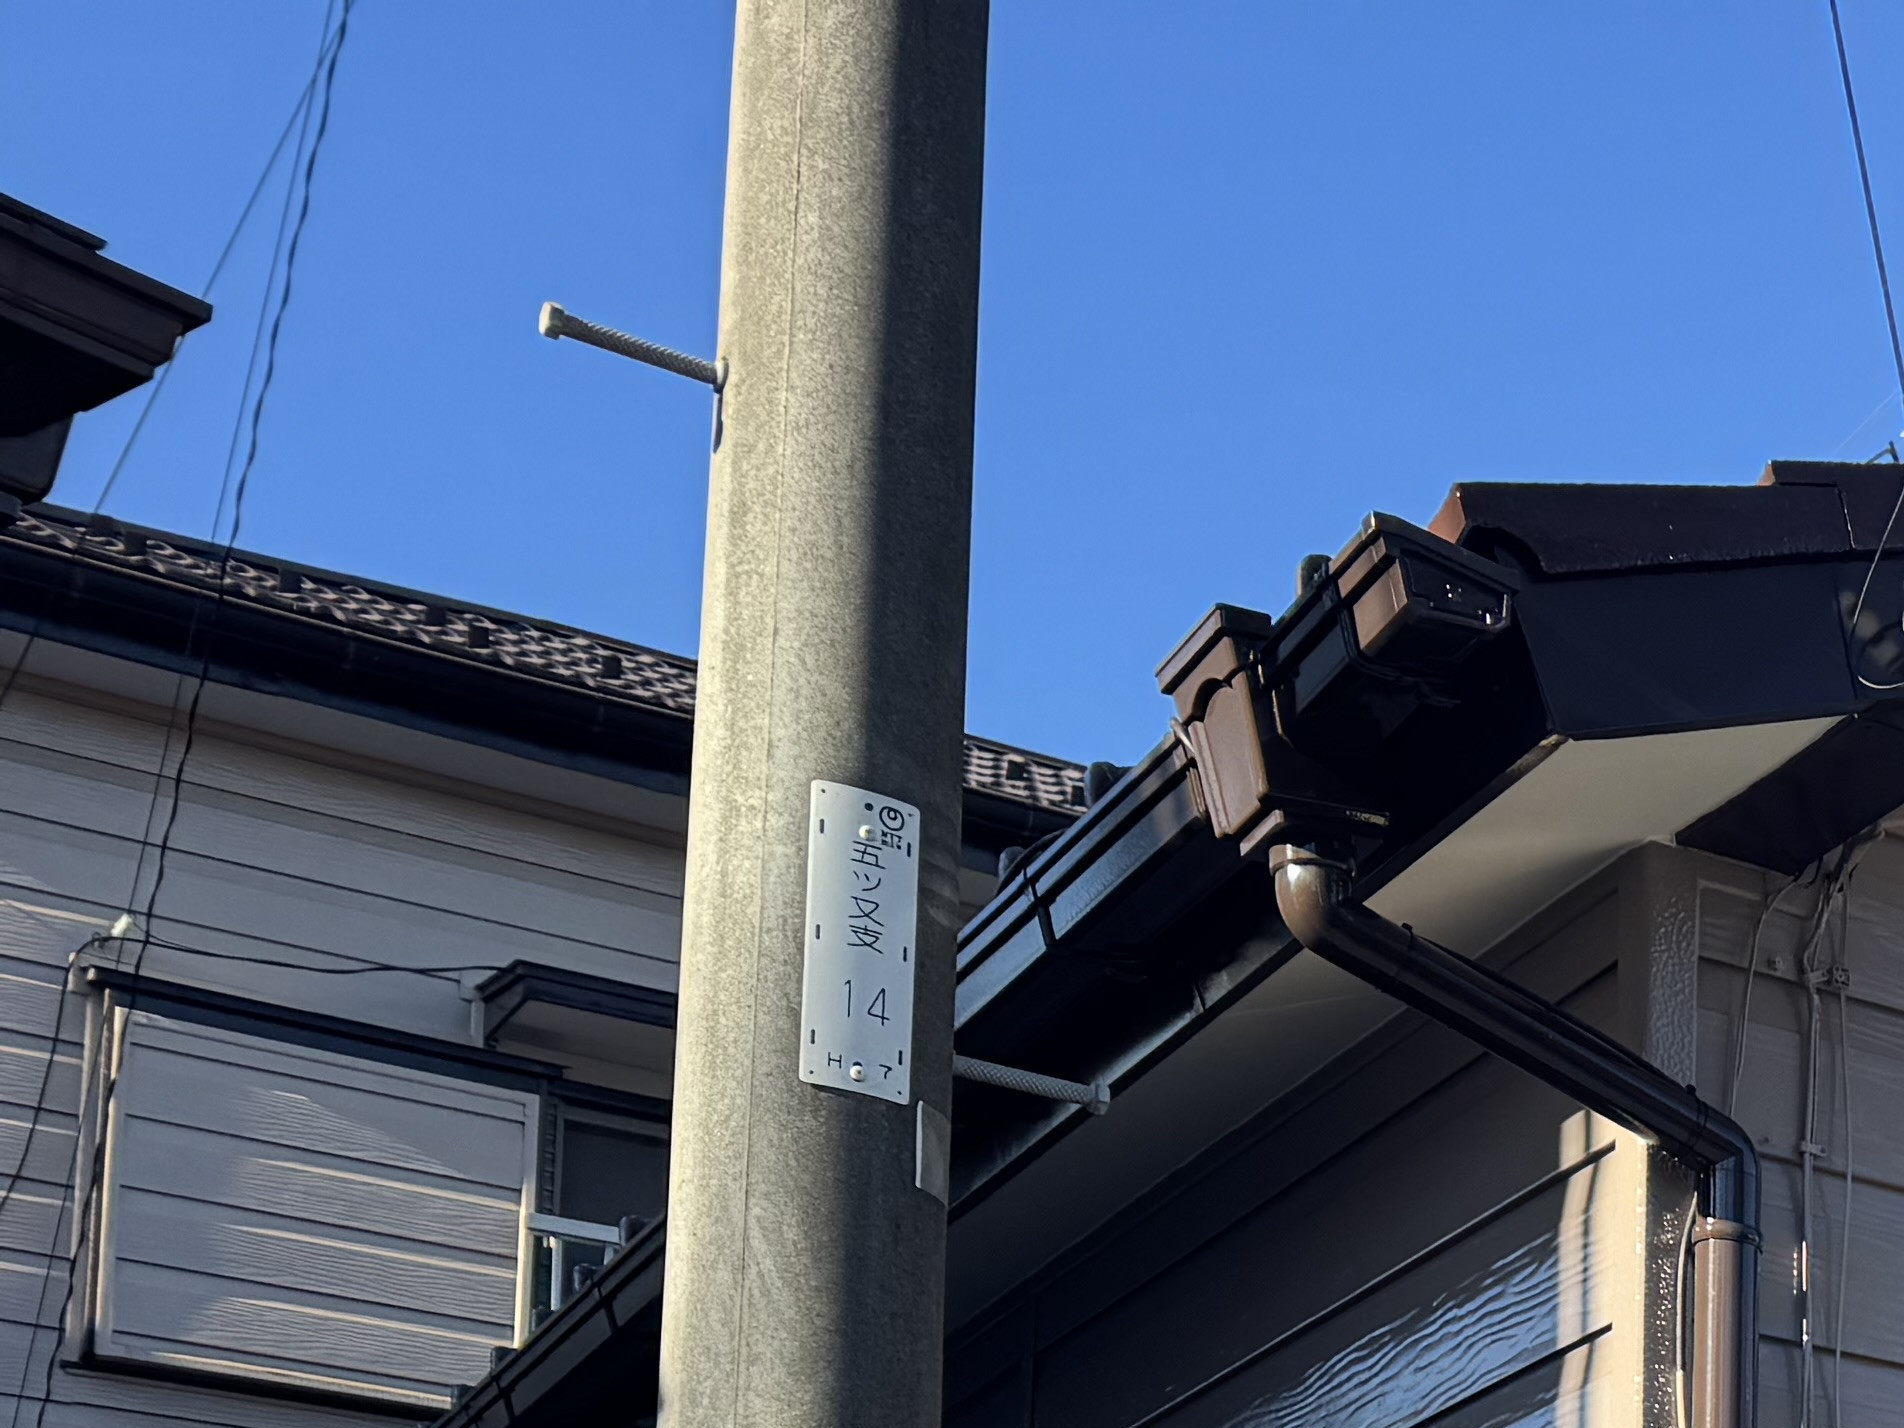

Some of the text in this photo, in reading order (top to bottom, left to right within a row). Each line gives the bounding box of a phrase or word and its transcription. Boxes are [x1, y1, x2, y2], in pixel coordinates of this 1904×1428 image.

[847, 840, 888, 955] 五ツ又支
[844, 979, 890, 1027] 14
[827, 1051, 893, 1080] H 7
